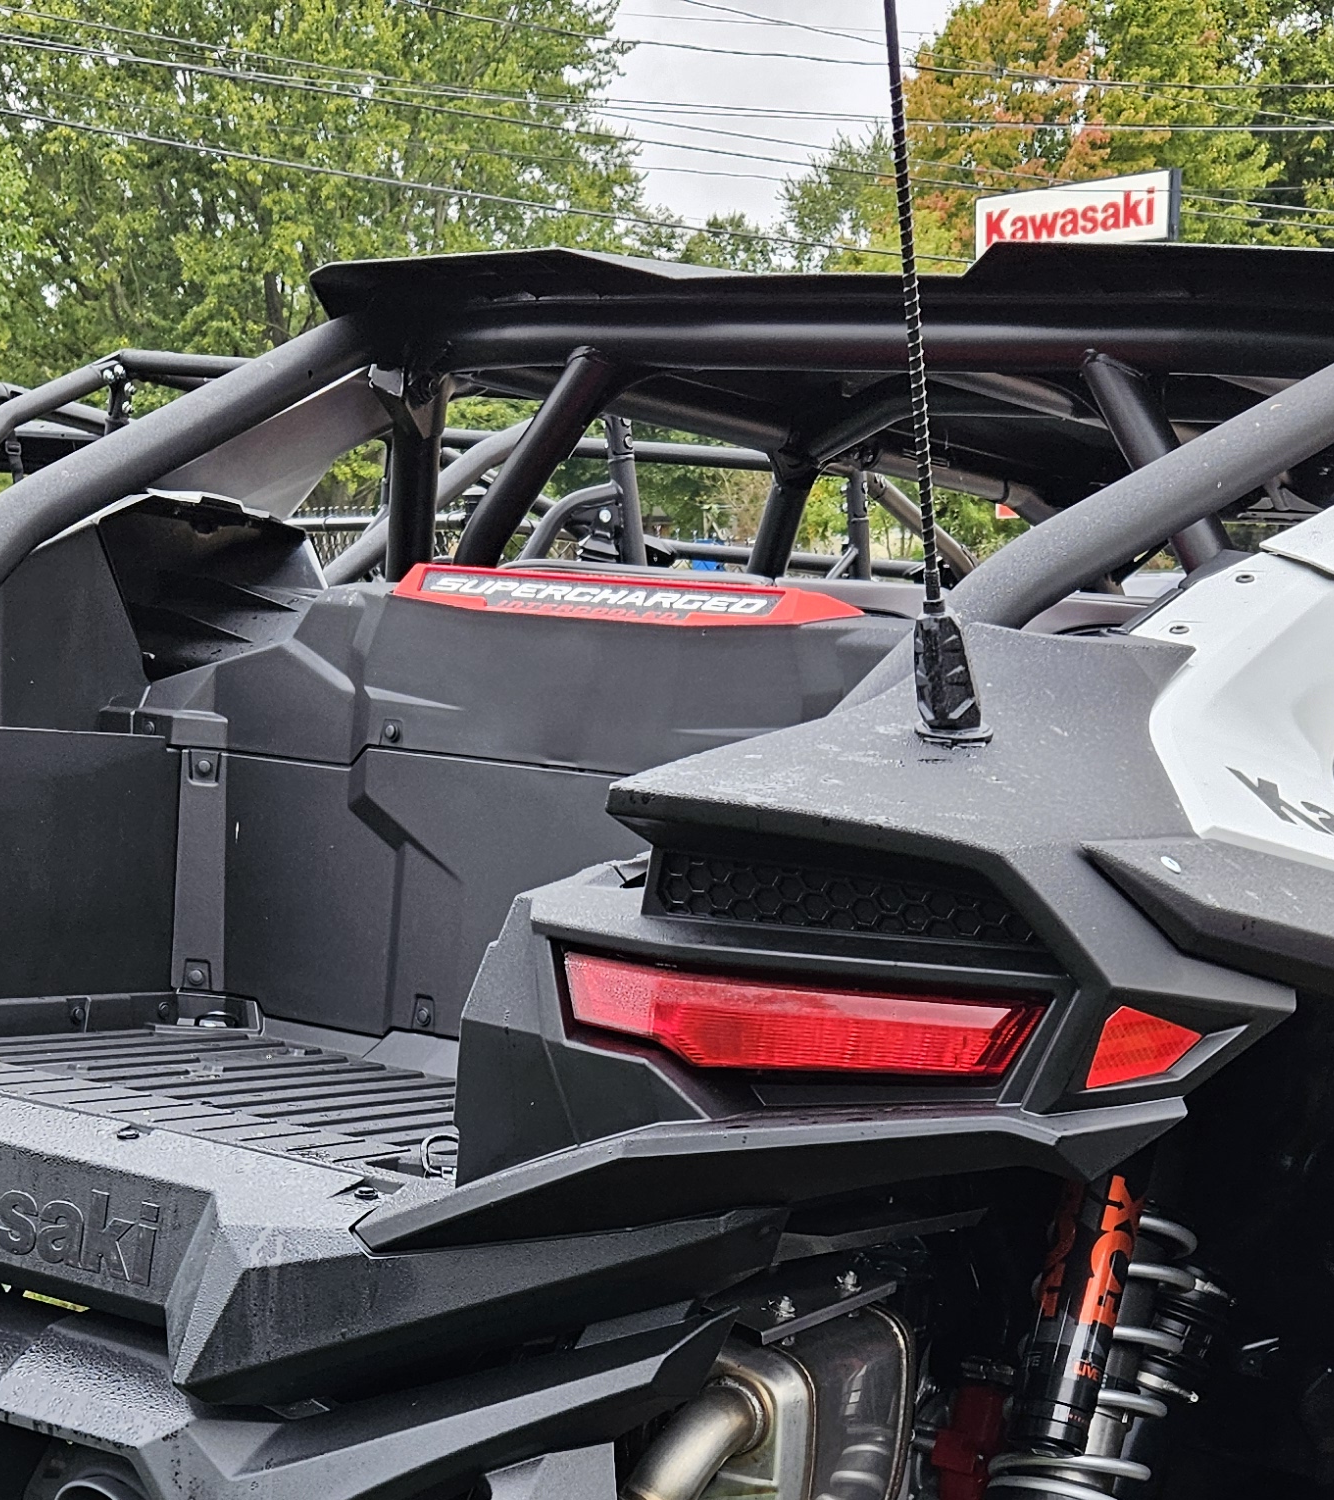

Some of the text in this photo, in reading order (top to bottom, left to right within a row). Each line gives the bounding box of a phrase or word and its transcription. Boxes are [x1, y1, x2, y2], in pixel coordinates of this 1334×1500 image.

[984, 185, 1157, 248] Kawasaki
[429, 575, 769, 615] SUPERCHARGED
[496, 599, 681, 623] INTERCOOLED
[1078, 1174, 1145, 1329] FOX
[1073, 1360, 1101, 1382] LIVE
